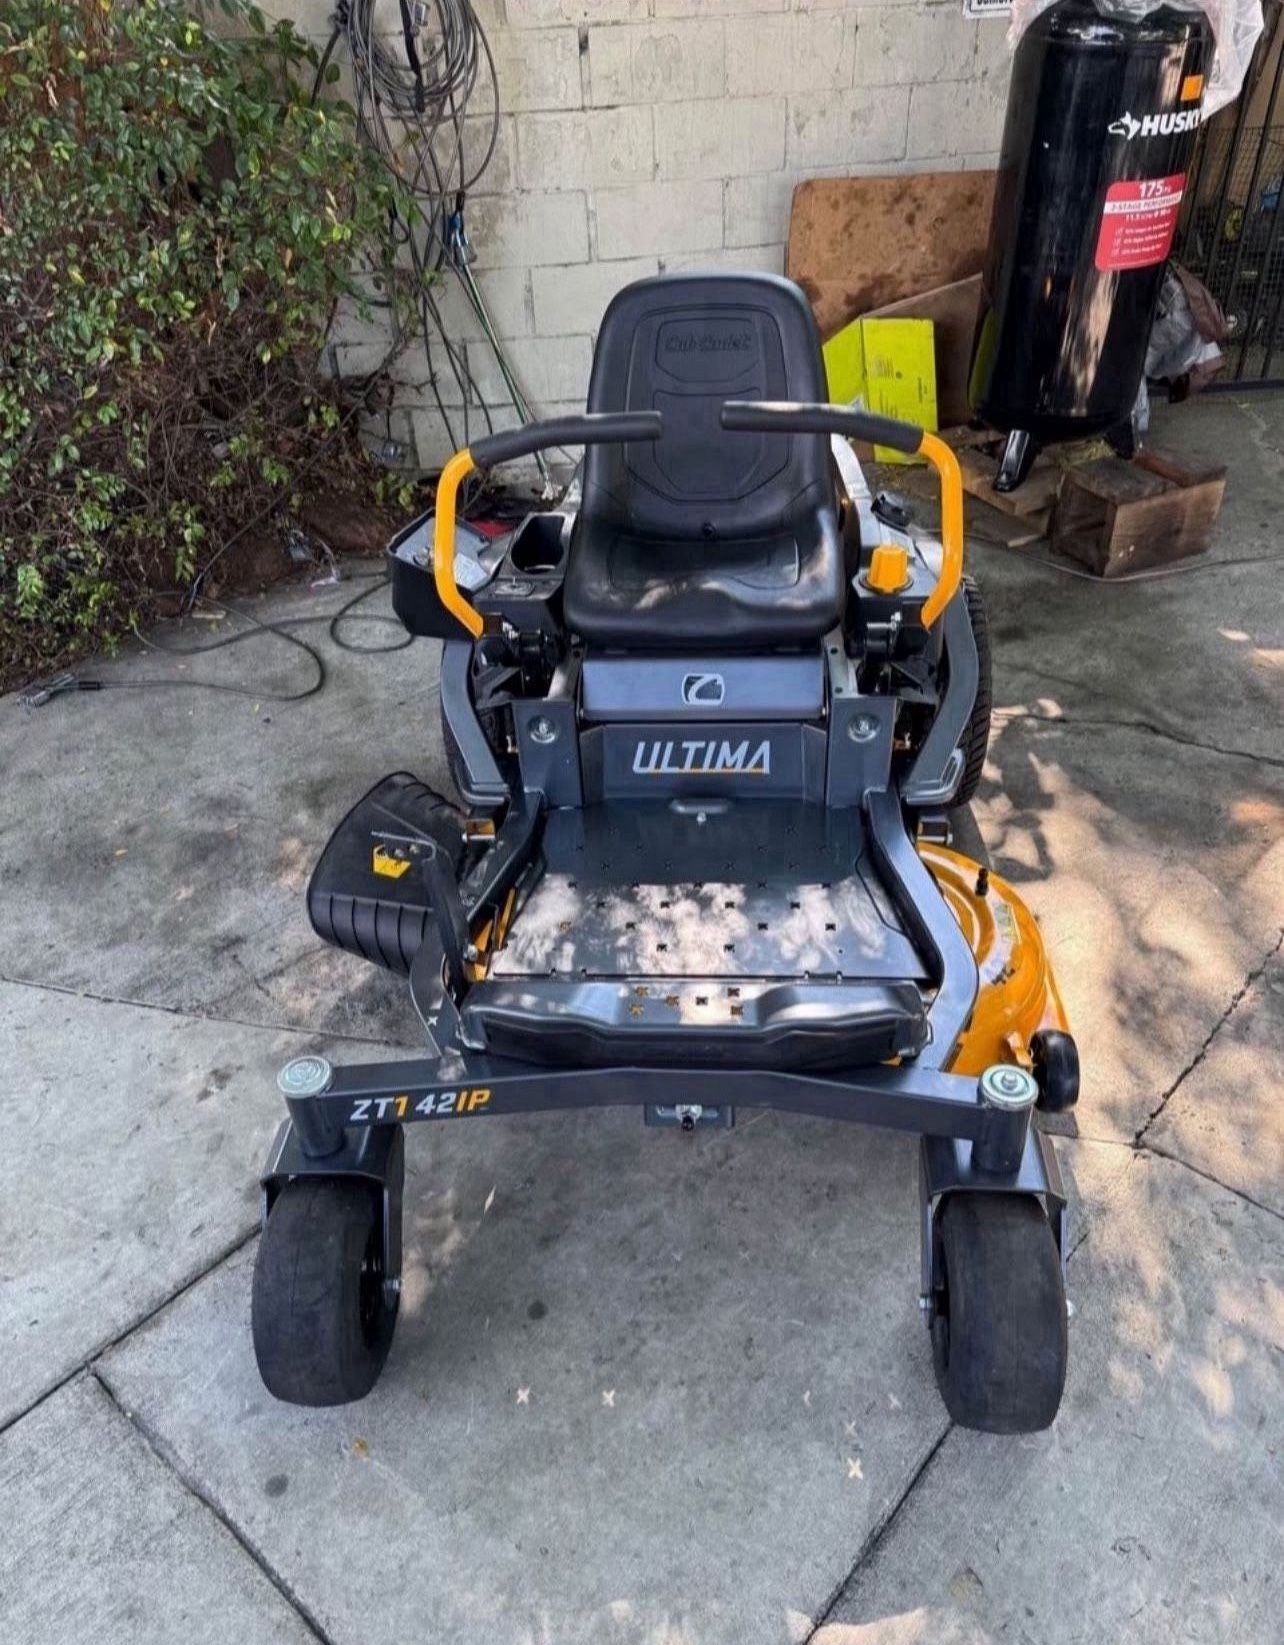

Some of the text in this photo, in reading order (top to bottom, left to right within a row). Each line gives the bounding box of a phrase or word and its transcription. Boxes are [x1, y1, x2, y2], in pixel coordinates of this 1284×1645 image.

[1139, 180, 1165, 198] 175
[632, 740, 771, 775] ULTIMA
[350, 1088, 492, 1122] ZT1 42IP
